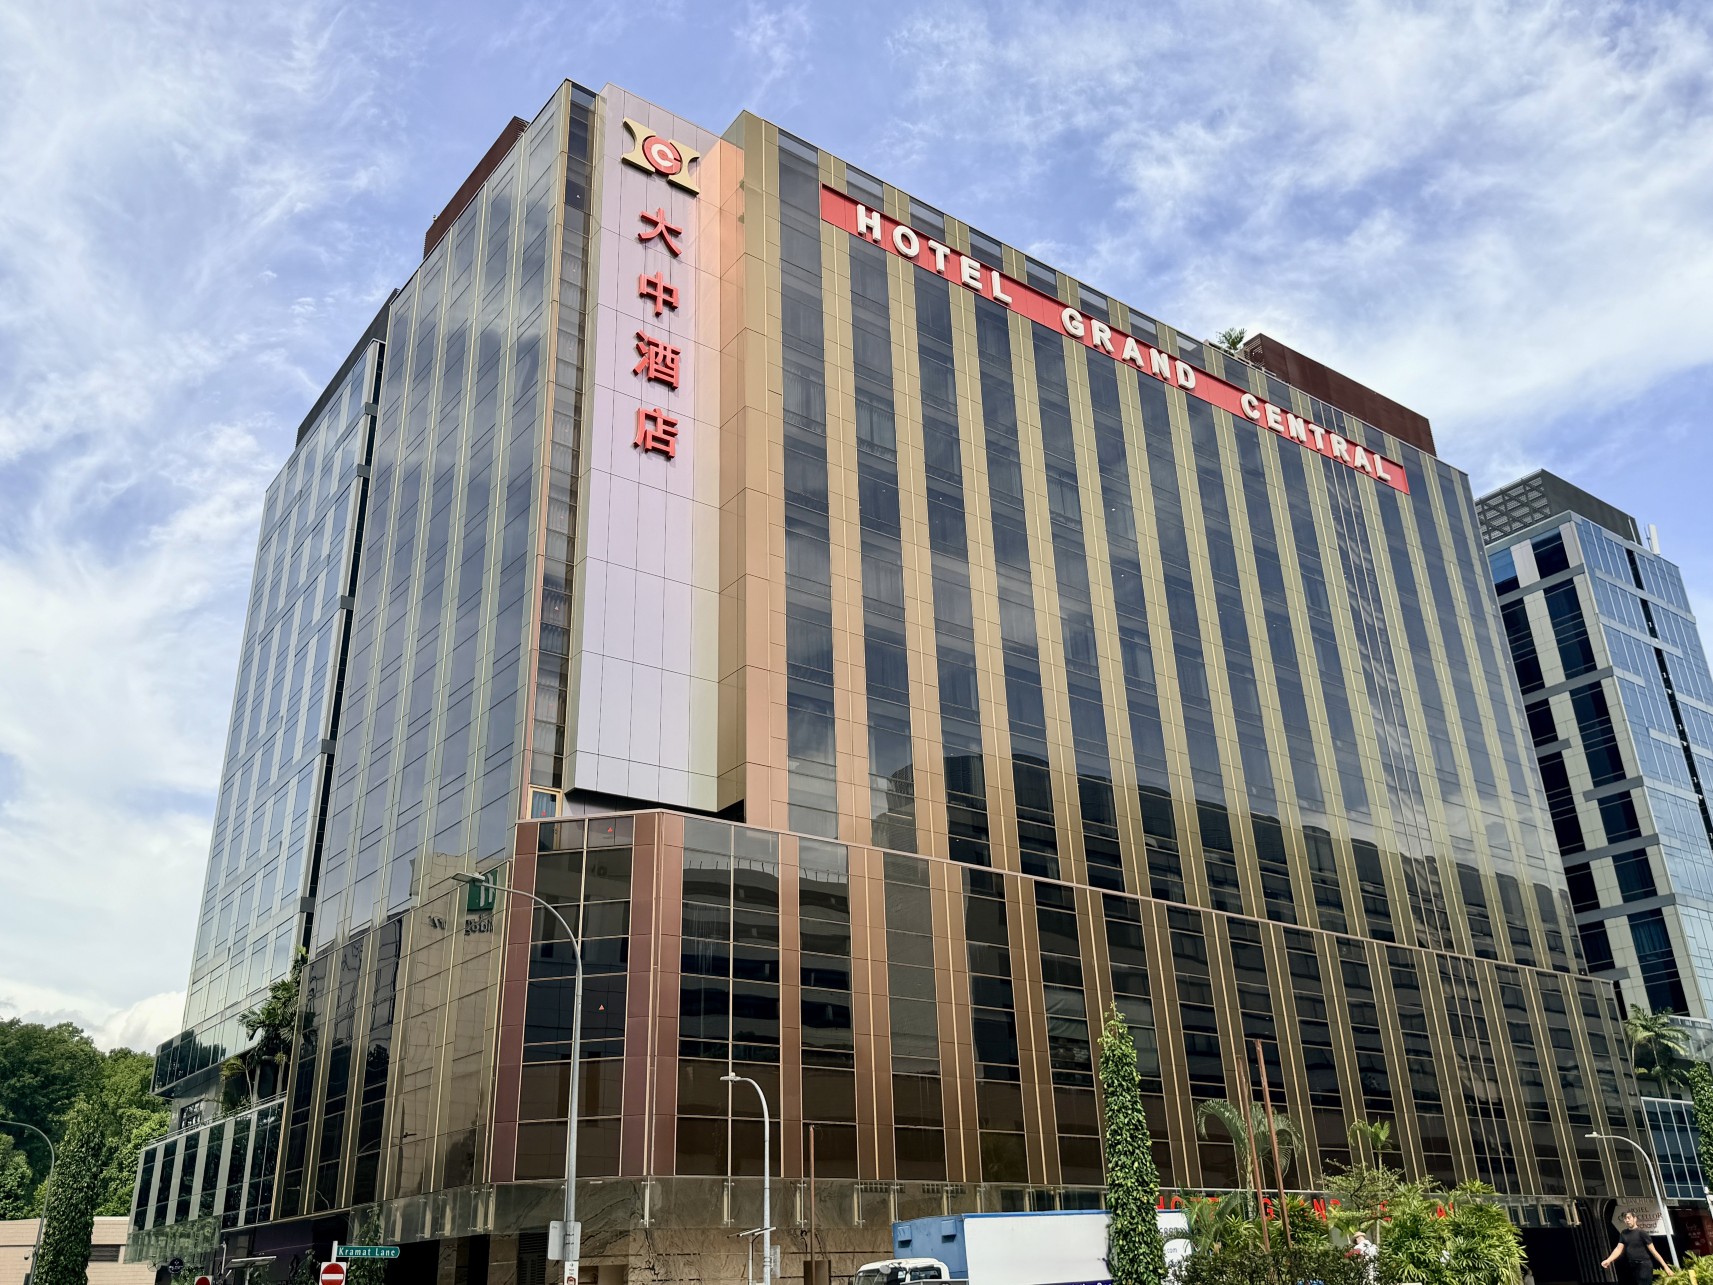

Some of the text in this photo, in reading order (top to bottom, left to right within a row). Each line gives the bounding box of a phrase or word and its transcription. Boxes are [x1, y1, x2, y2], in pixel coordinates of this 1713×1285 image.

[633, 206, 683, 460] 大中酒店
[857, 203, 1391, 482] HOTEL GRAND CENTRAL
[338, 1247, 396, 1256] Kramat Lane
